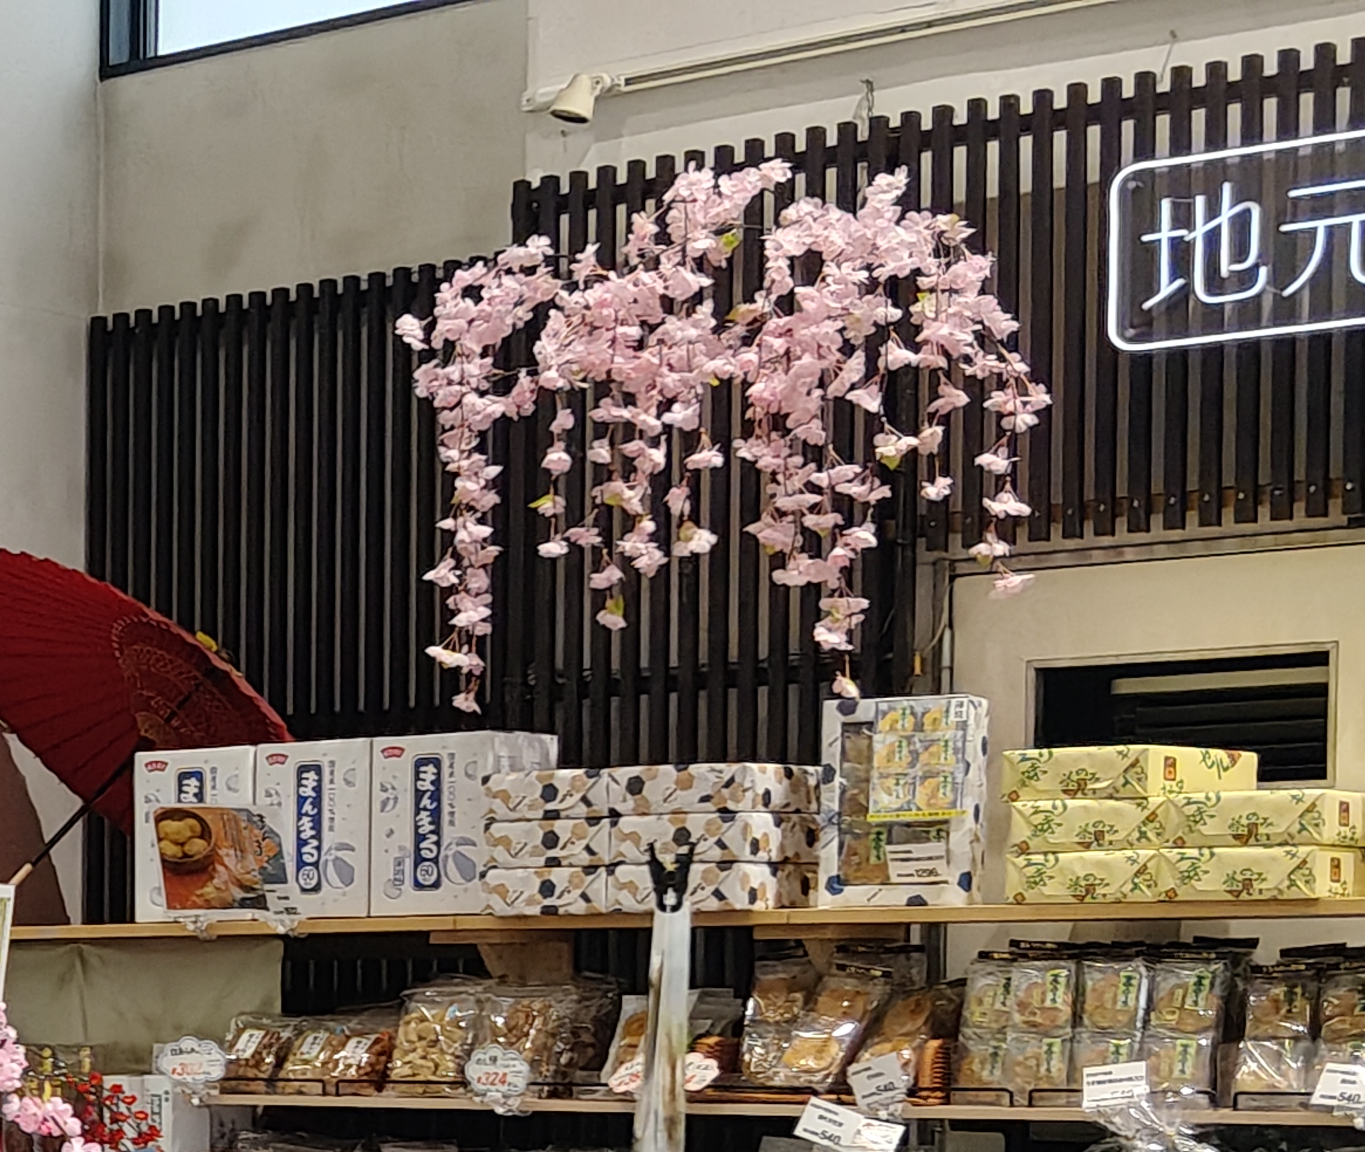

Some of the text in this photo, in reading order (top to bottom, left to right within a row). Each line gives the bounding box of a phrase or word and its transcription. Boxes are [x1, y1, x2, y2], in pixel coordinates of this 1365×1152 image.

[1141, 178, 1365, 312] 地元
[297, 769, 319, 863] まんまる
[415, 762, 439, 860] まんまる
